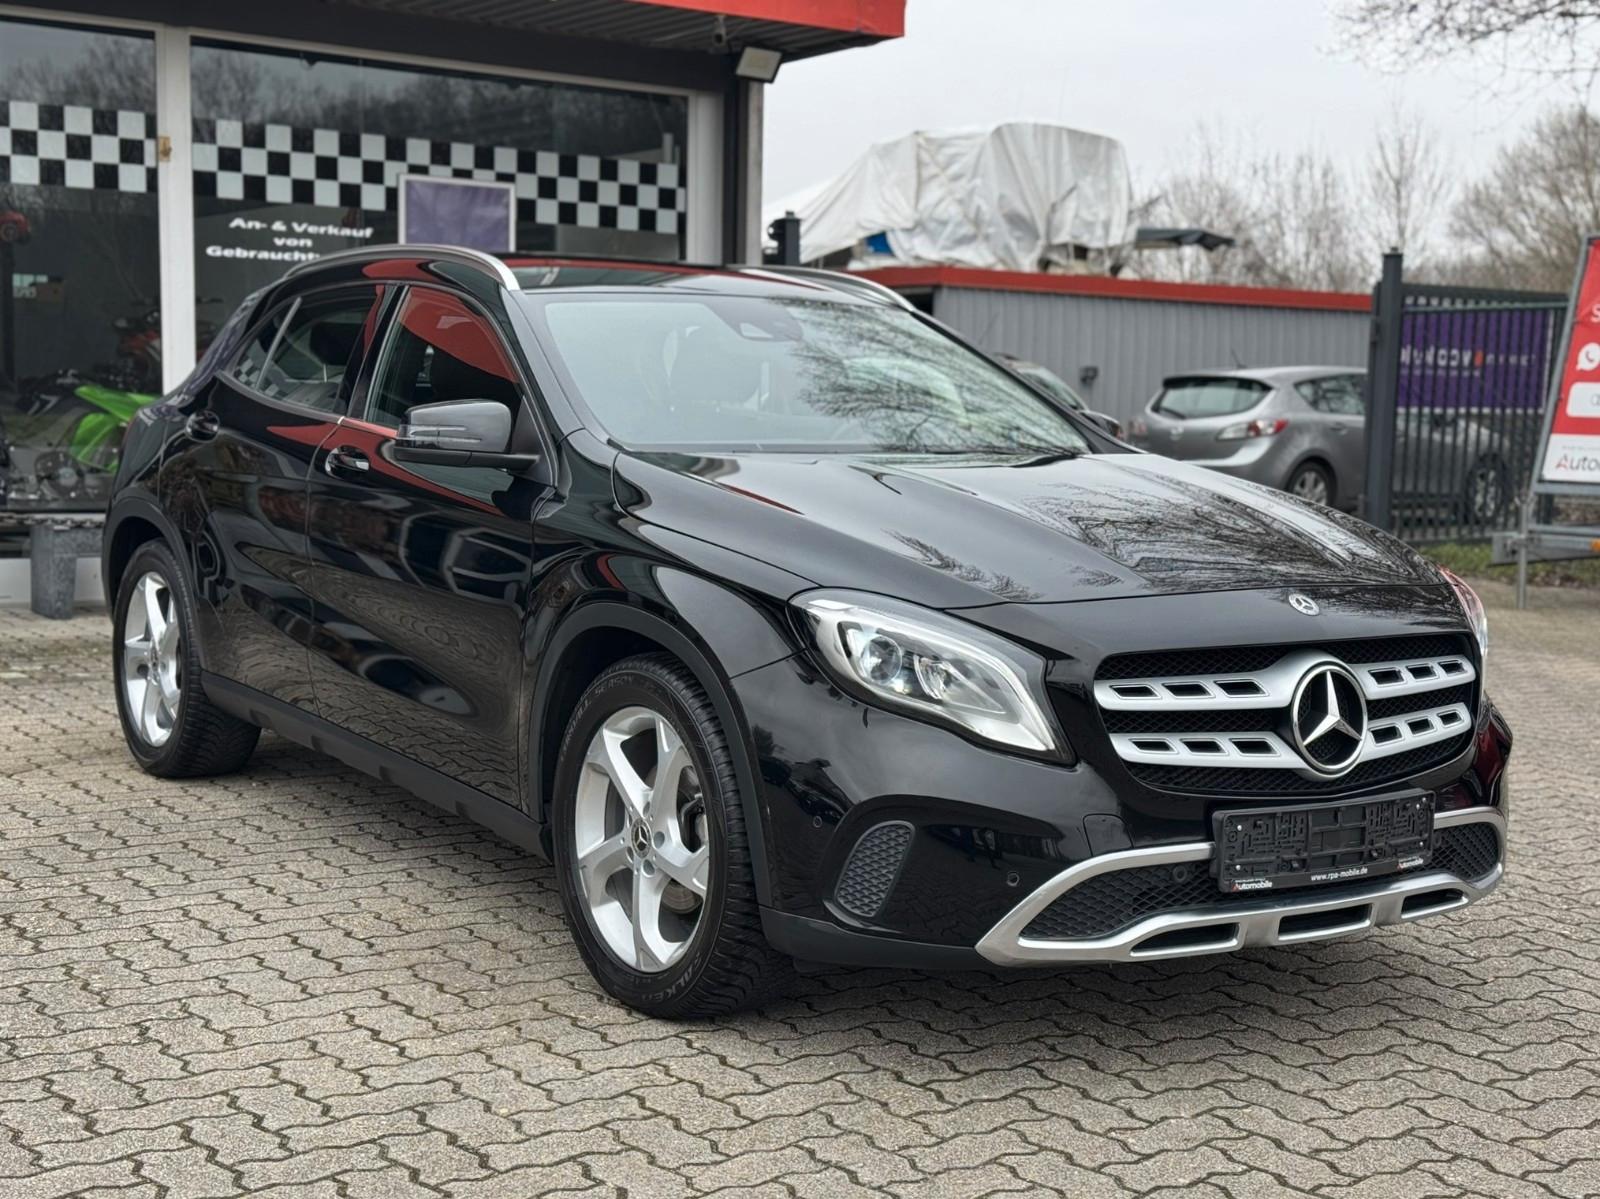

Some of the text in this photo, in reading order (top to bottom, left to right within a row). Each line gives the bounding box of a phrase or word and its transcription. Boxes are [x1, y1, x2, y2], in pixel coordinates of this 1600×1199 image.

[229, 217, 374, 239] An- & Verkauf
[273, 237, 313, 248] von
[1555, 452, 1600, 473] Auto
